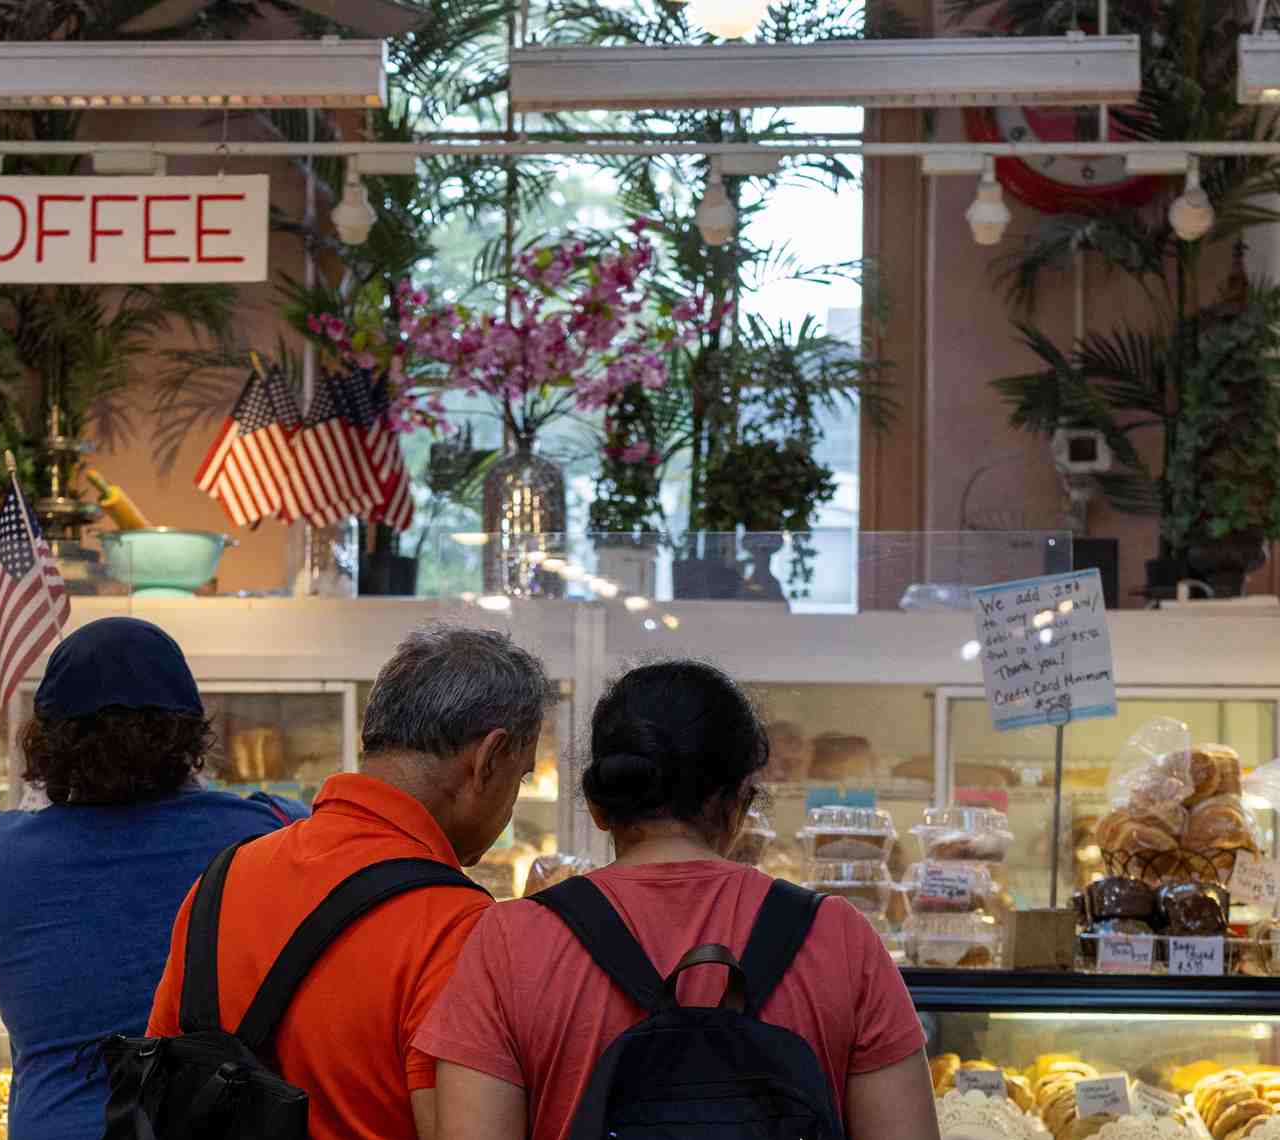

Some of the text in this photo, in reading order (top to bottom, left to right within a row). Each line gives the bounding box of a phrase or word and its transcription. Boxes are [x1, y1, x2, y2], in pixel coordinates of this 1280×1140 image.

[978, 596, 1005, 615] We
[1016, 587, 1041, 605] add
[993, 652, 1066, 681] Thank you!
[994, 687, 1030, 706] Credit
[1032, 677, 1061, 696] Card
